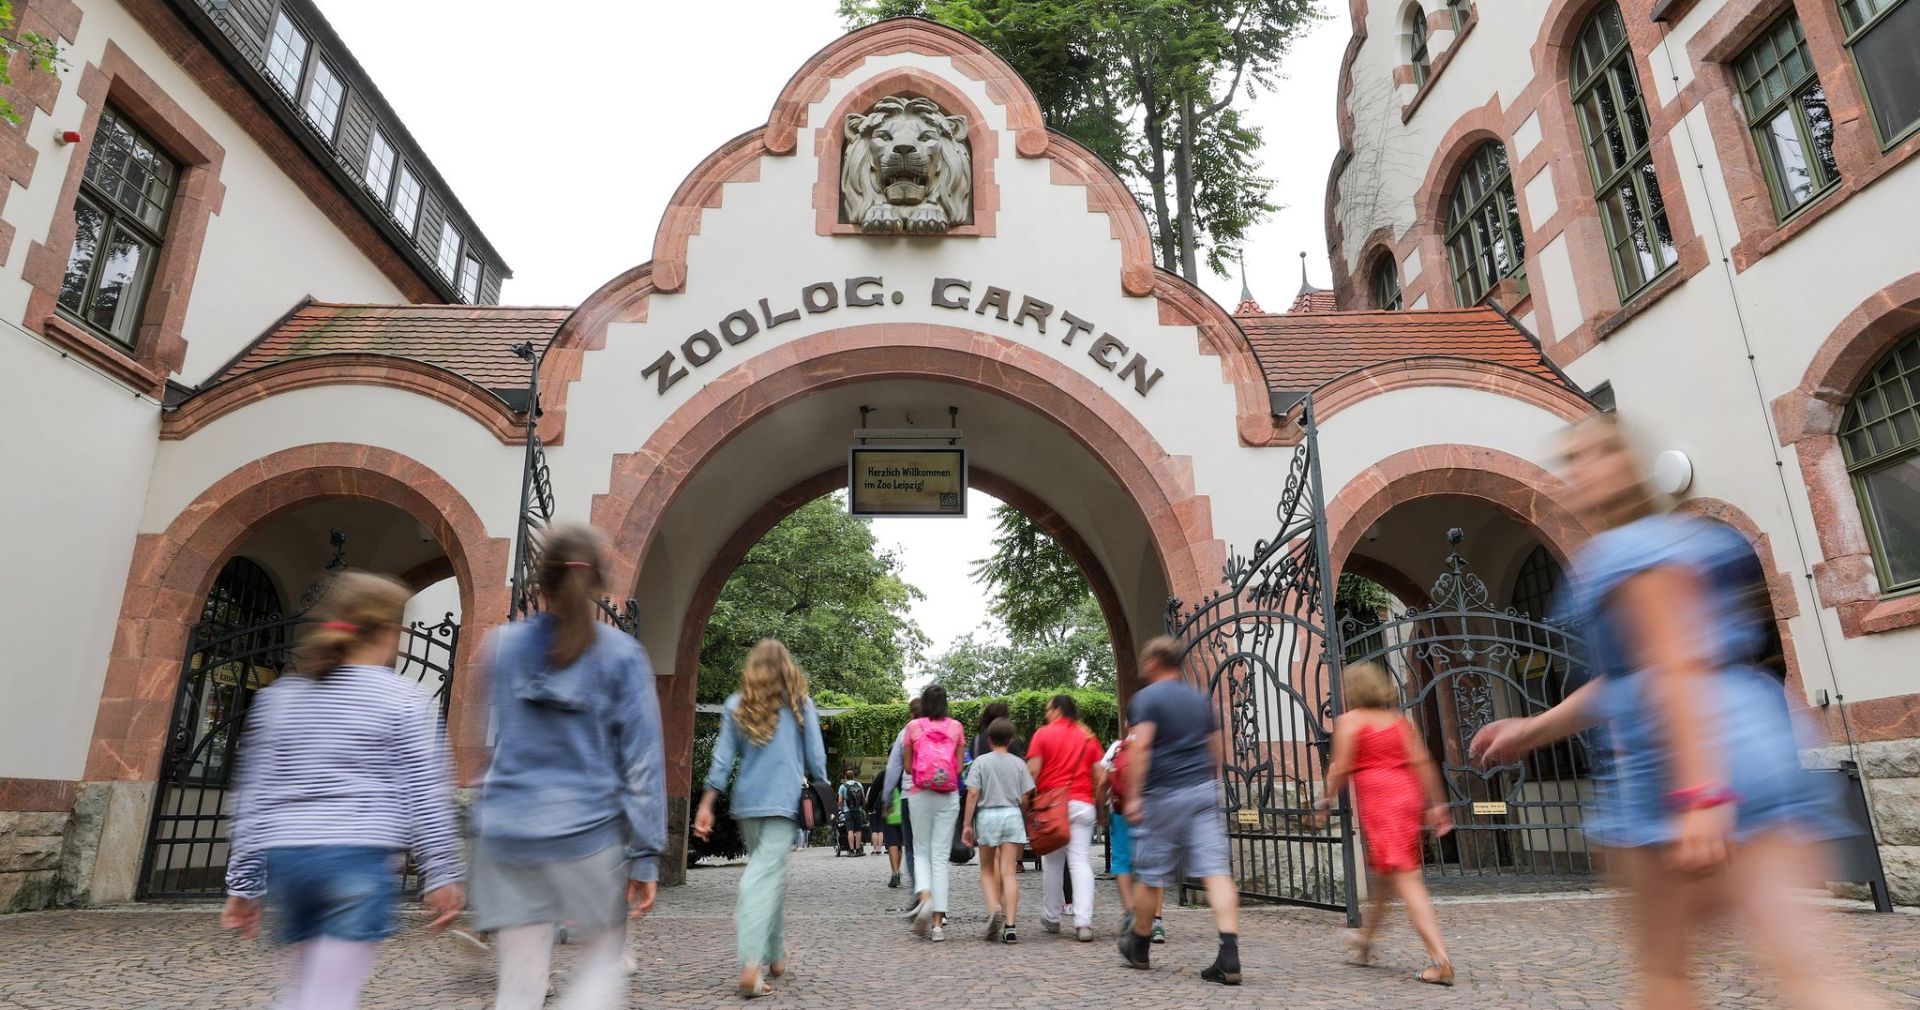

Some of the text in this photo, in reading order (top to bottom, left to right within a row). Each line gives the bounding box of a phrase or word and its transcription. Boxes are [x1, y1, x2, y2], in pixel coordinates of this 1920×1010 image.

[641, 276, 1165, 397] ZOOLOG. GARTEN
[868, 467, 951, 477] Herzlich Willkommen
[864, 480, 925, 492] im Zoo Leipzig!
